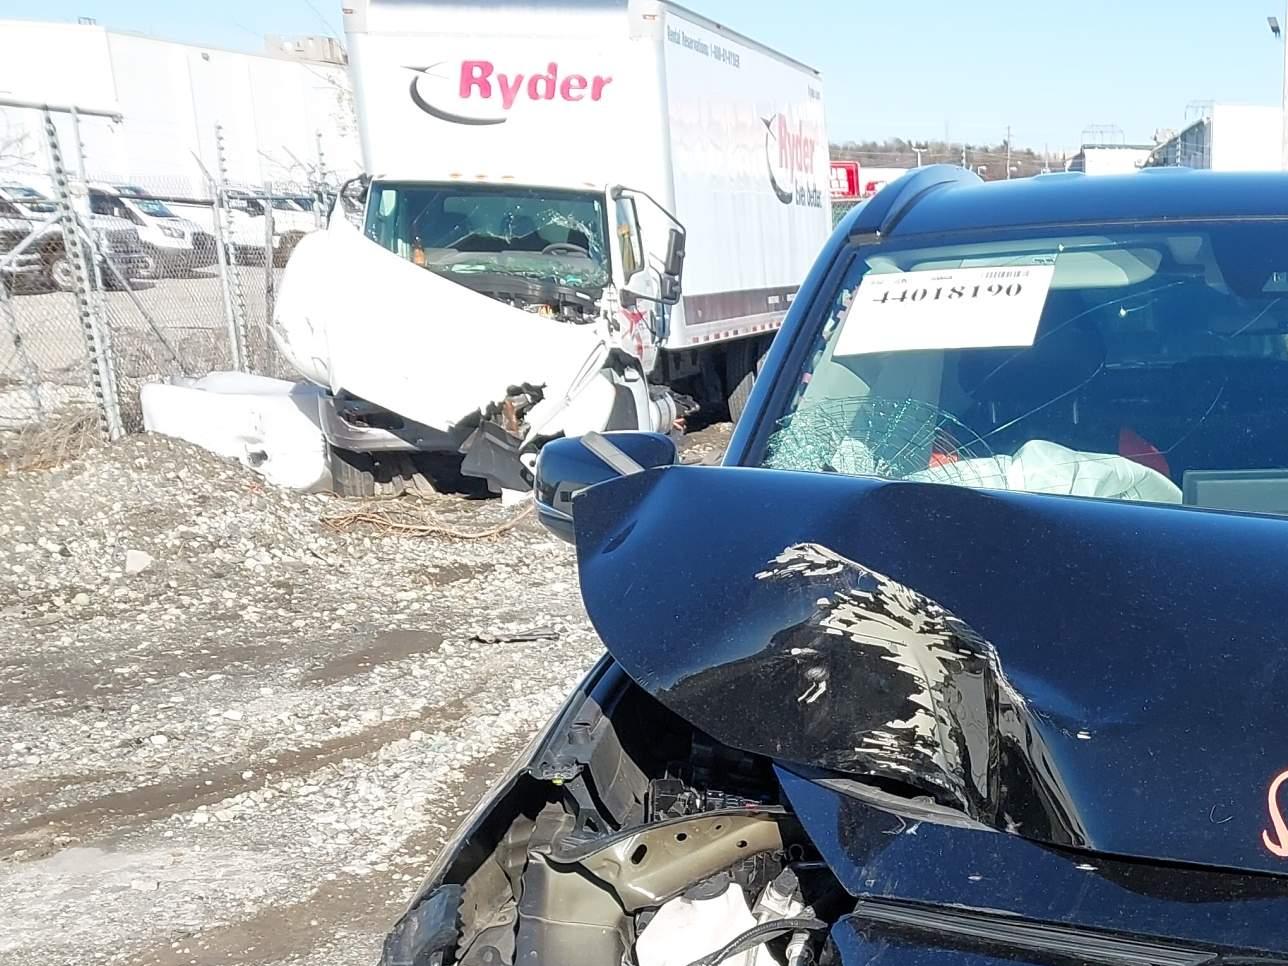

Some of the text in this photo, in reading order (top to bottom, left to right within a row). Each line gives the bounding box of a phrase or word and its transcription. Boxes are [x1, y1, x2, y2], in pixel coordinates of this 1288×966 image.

[459, 60, 613, 110] Ryder
[778, 112, 815, 184] Ryder
[873, 283, 1023, 304] 44018190
